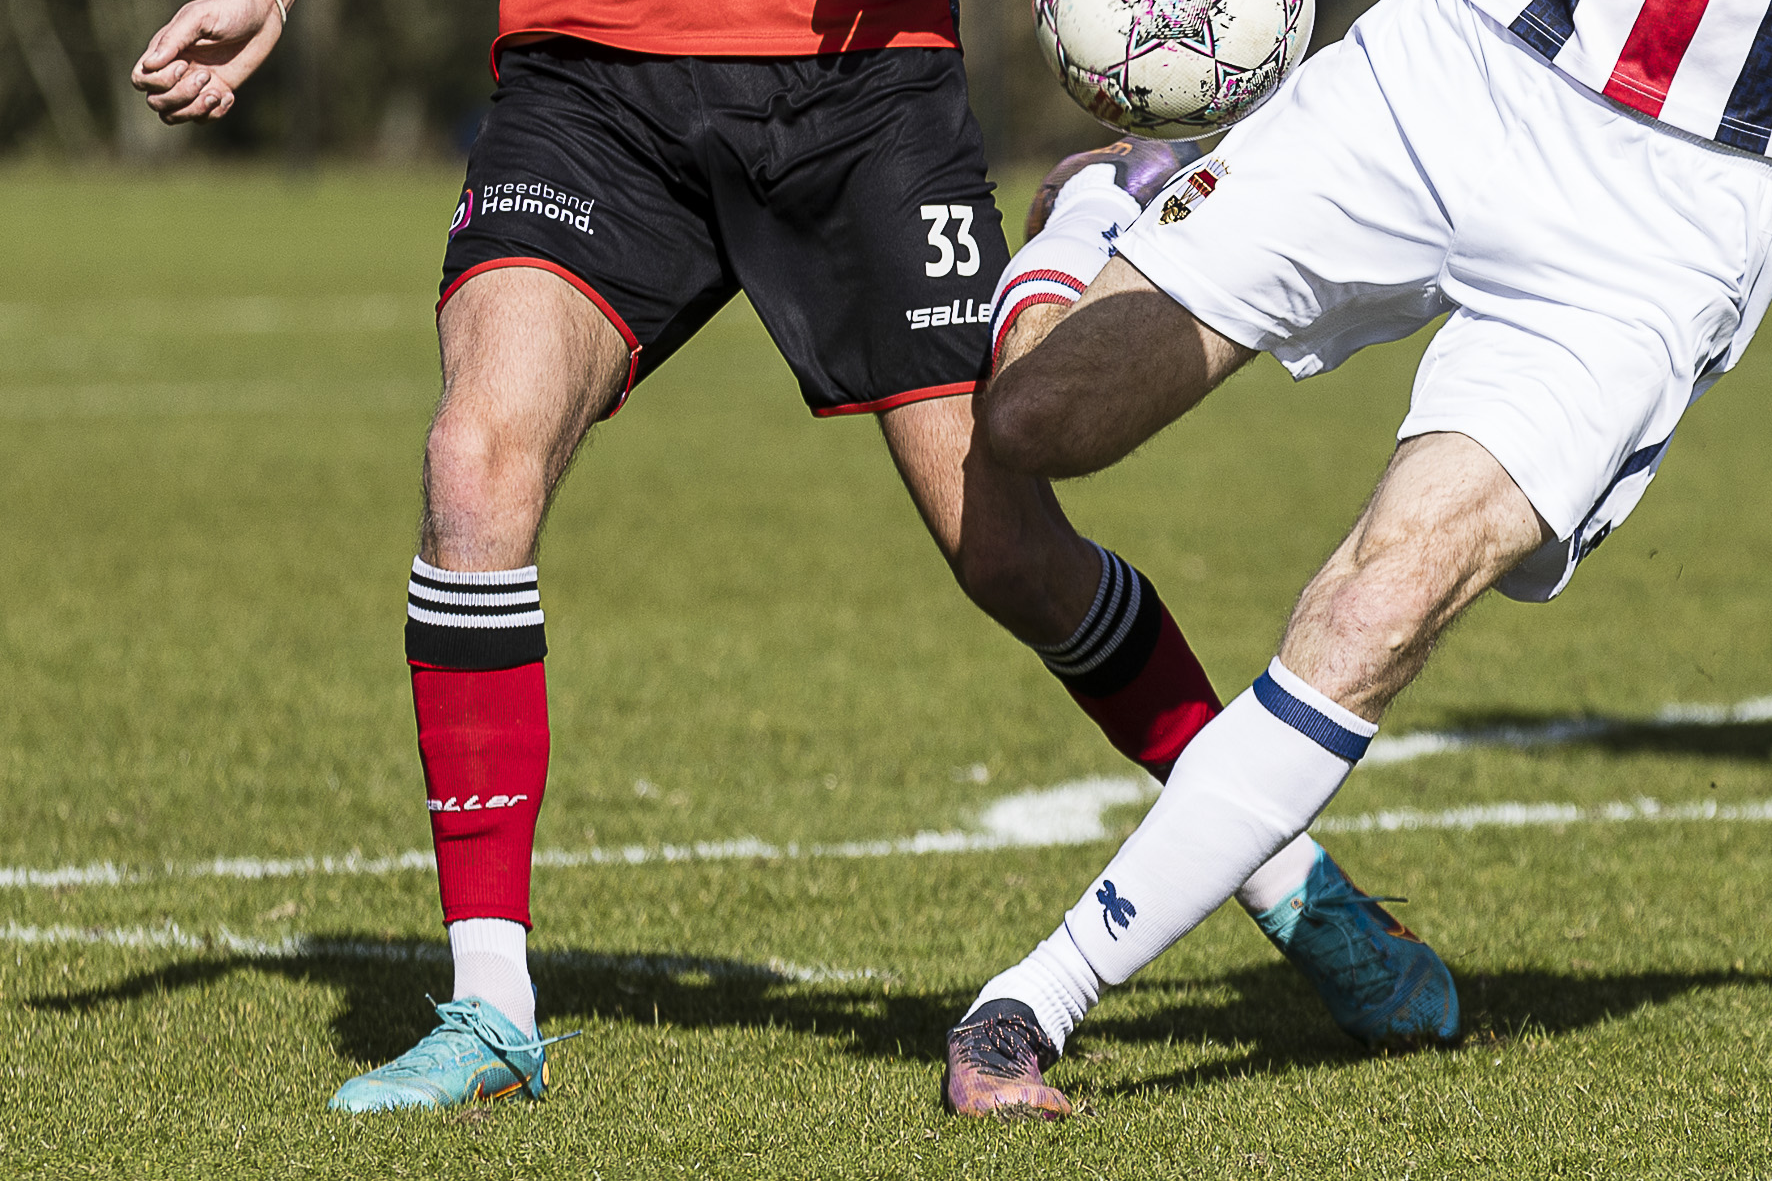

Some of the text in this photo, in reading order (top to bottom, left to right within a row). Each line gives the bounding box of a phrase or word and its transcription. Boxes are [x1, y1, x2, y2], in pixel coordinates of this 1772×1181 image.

[481, 194, 595, 236] Helmond.
[483, 182, 595, 215] breedband
[920, 204, 980, 278] 33
[905, 298, 992, 330] salle
